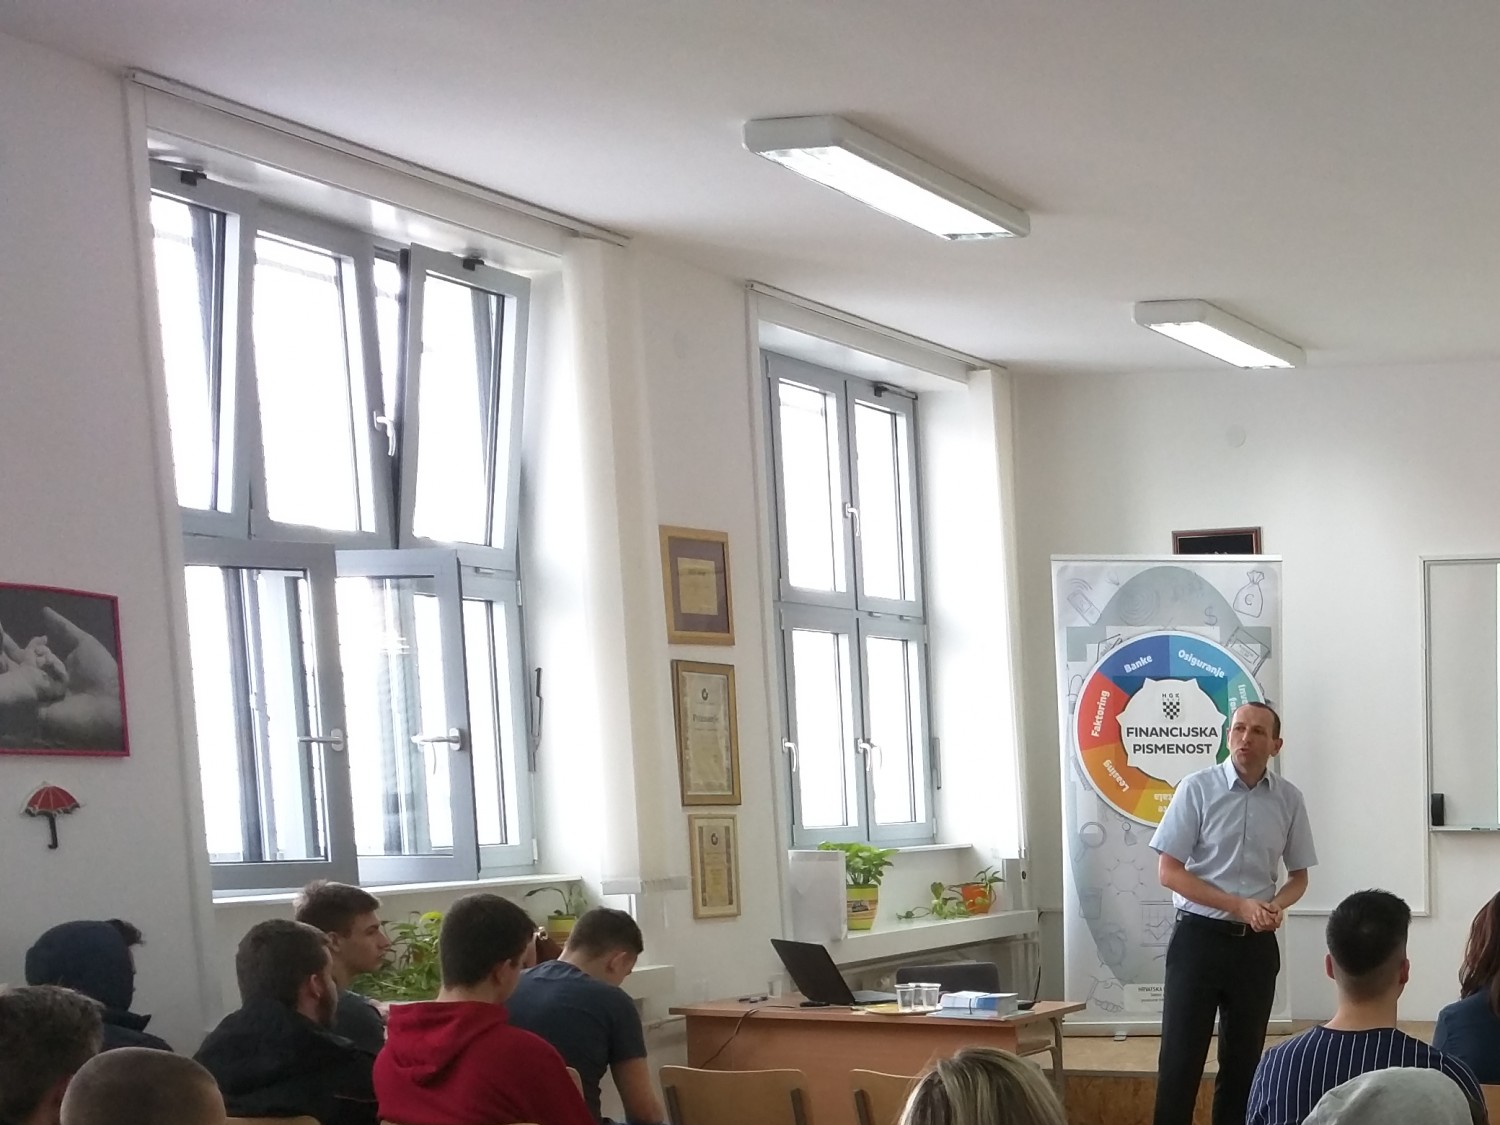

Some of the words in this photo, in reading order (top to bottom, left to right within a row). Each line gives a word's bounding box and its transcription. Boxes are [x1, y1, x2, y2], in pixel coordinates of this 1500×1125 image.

[1123, 653, 1153, 673] Banke
[1178, 649, 1226, 679] Osiguranje
[1090, 690, 1111, 738] Faktoring
[1126, 726, 1218, 738] FINANCIJSKA
[1132, 743, 1213, 755] PISMENOST
[1103, 760, 1130, 792] Leasing
